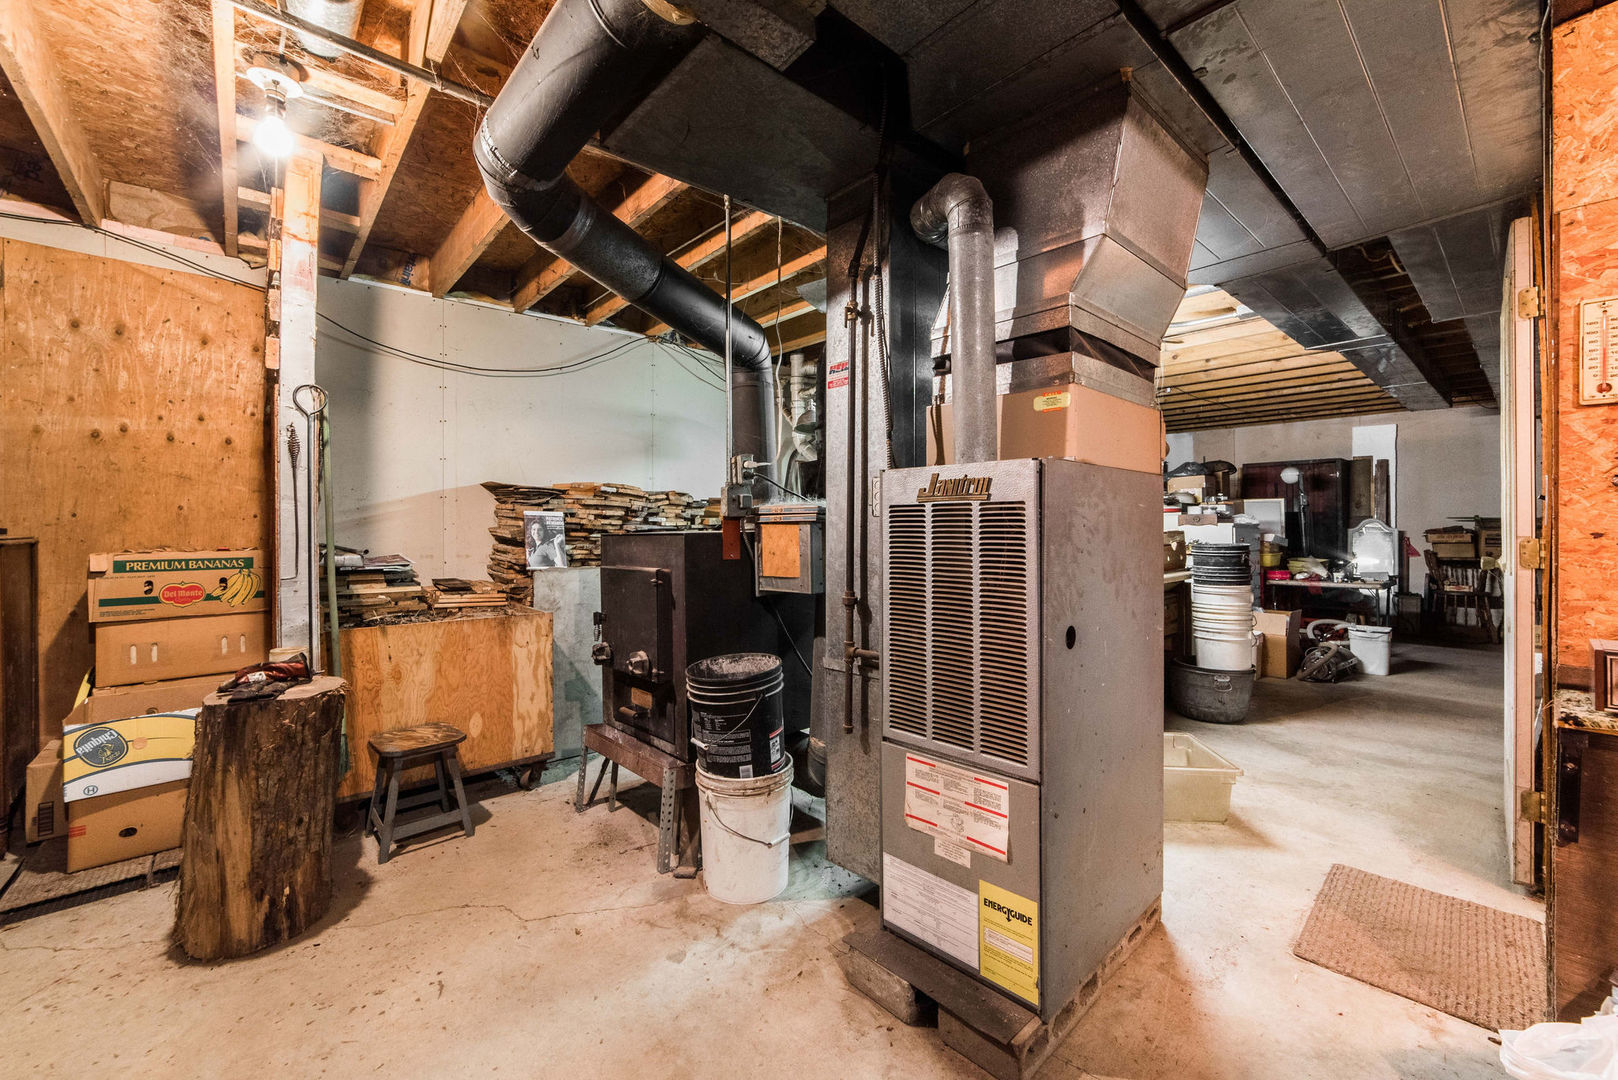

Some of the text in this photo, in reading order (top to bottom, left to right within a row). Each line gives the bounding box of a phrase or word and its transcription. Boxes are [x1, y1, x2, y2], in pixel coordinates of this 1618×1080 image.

[125, 559, 245, 571] PREMIUM BANANAS
[75, 729, 118, 757] Chiquita
